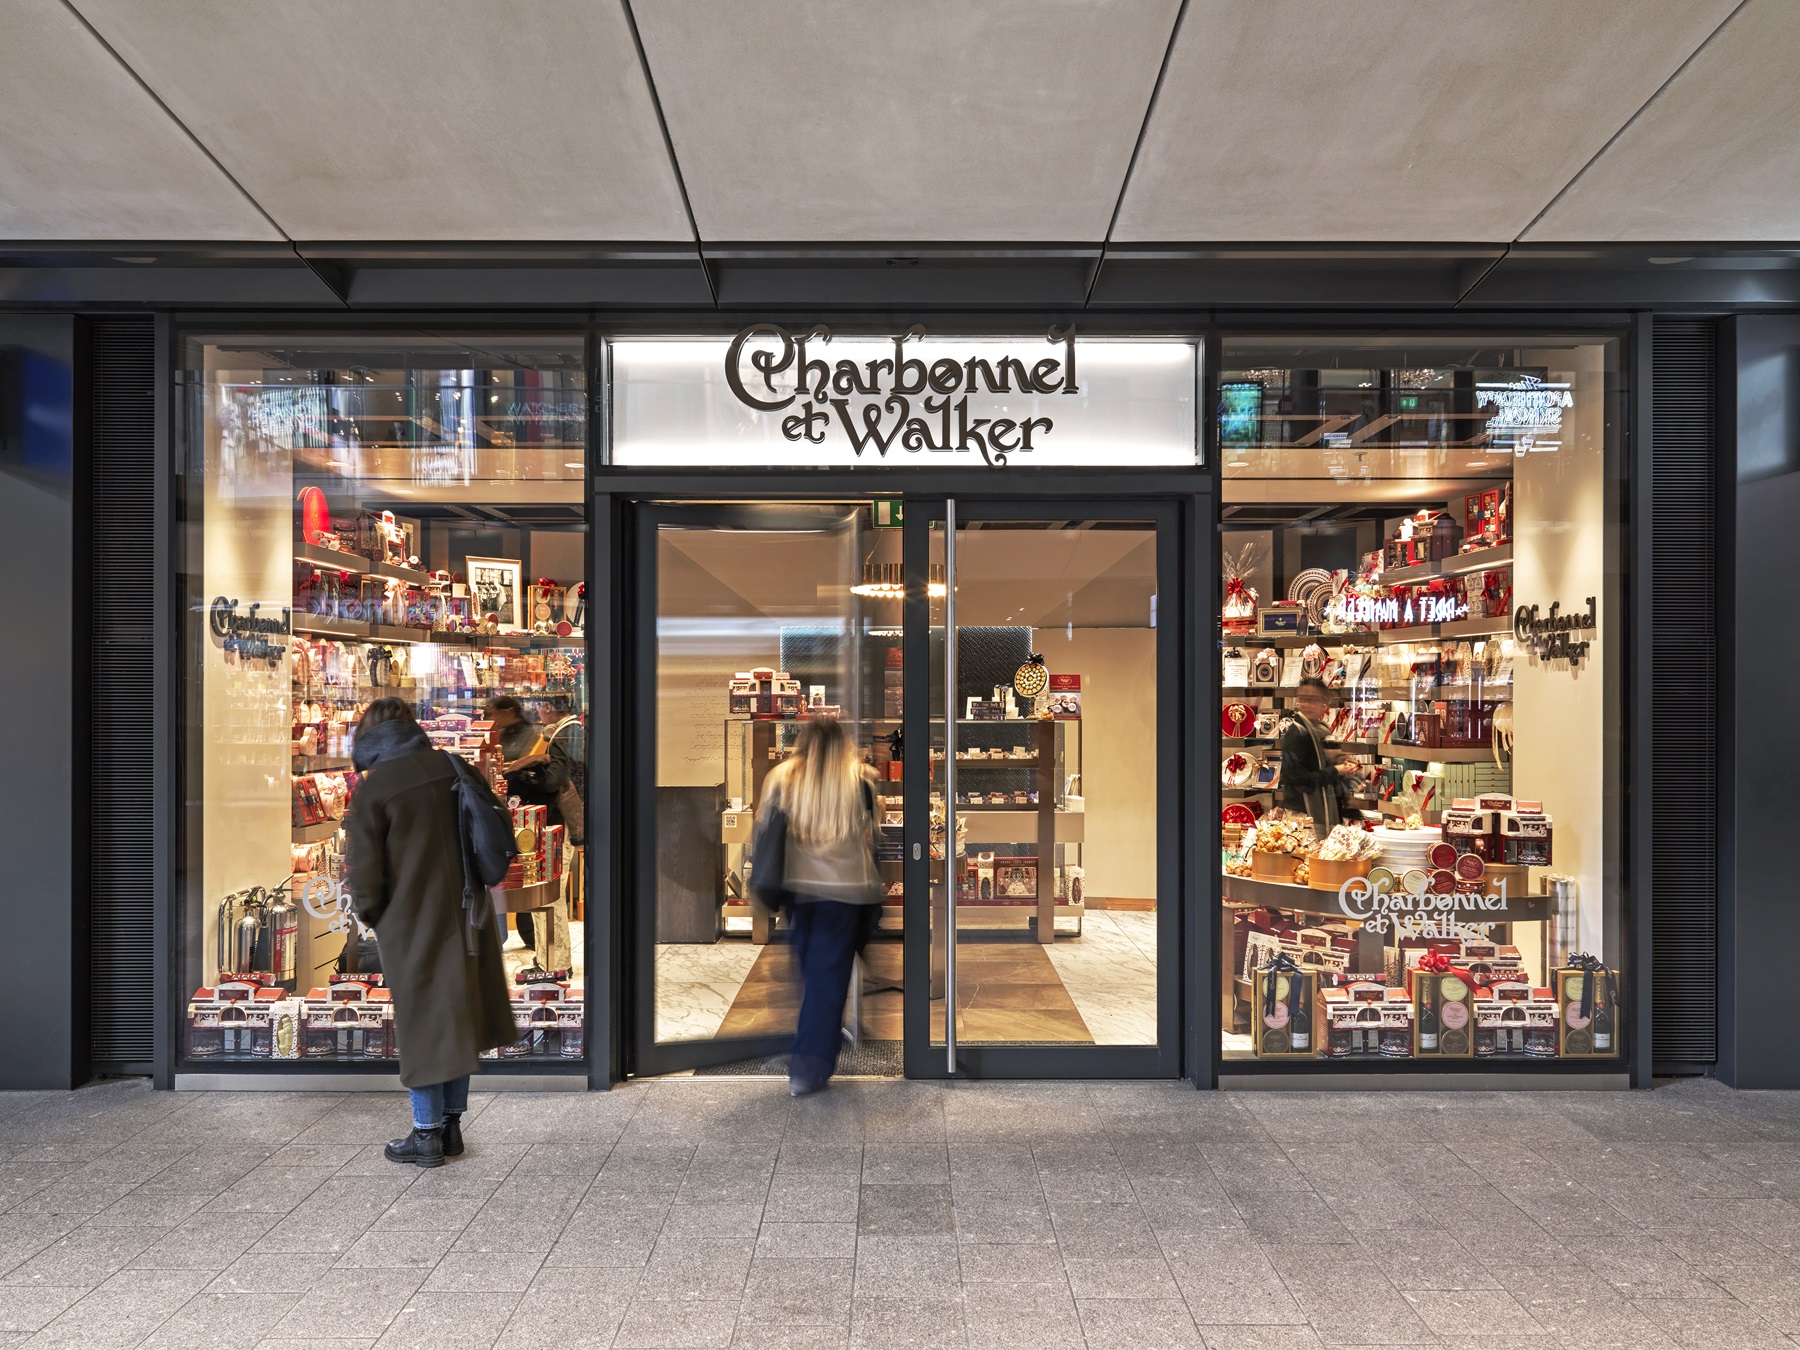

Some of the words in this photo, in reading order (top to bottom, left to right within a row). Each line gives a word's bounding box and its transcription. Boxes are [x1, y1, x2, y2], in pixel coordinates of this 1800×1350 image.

[724, 322, 1080, 411] Charbonnel
[781, 403, 830, 445] et
[829, 394, 1055, 471] Walker
[1338, 877, 1508, 920] Charbonnel
[329, 914, 353, 935] et
[1365, 914, 1390, 935] et
[1388, 910, 1496, 947] Walker
